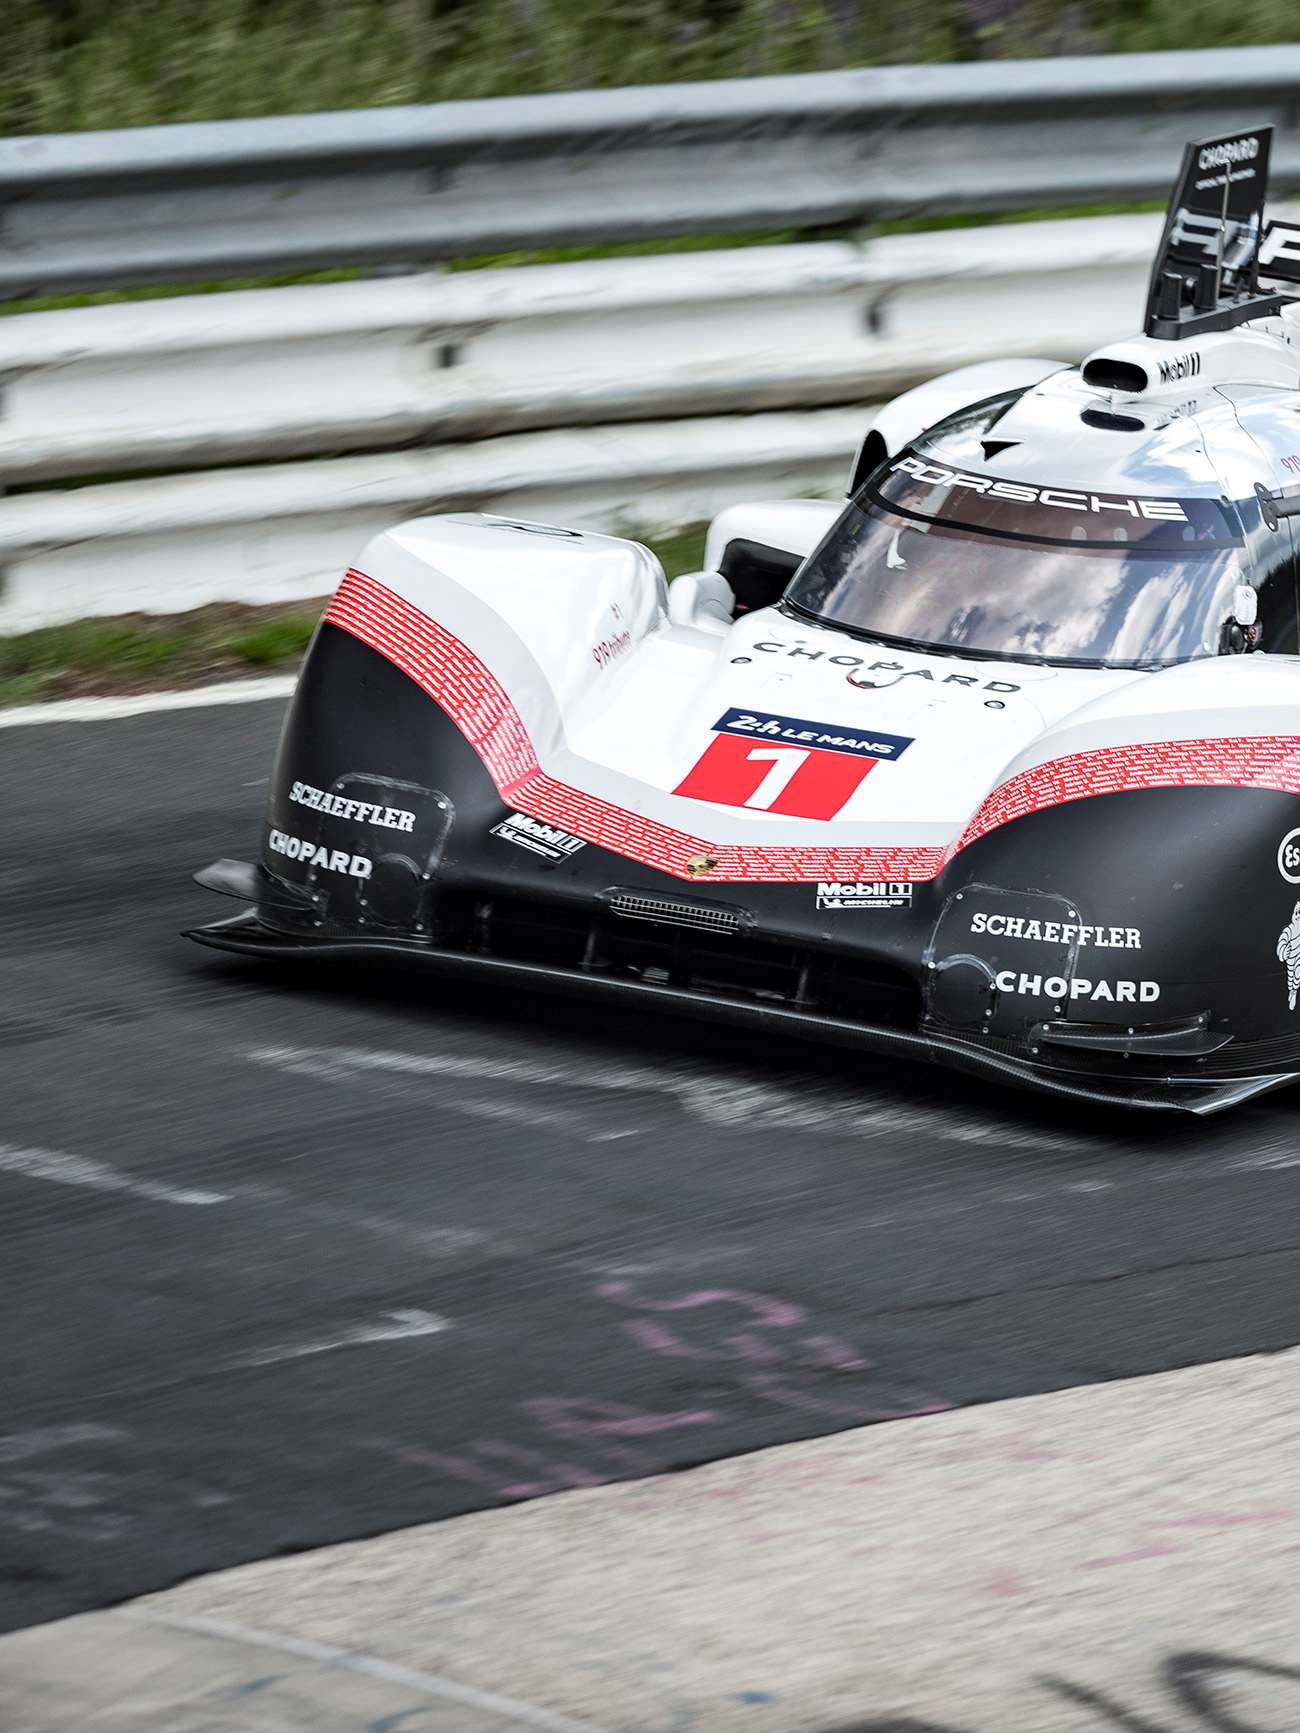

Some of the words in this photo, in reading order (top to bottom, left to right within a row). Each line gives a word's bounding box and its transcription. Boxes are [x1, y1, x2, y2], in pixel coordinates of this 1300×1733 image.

[1157, 354, 1190, 384] Mobil
[890, 457, 1189, 522] PORSCHE
[753, 642, 1022, 693] CHOPARD
[781, 728, 819, 742] LE
[816, 734, 896, 755] MANS
[743, 747, 812, 811] 1
[288, 781, 416, 832] SCHAEFFLER
[504, 812, 568, 844] Mobil
[269, 829, 373, 879] CHOPARD
[817, 882, 886, 896] Mobil
[970, 912, 1142, 949] SCHAEFFLER
[995, 970, 1160, 1002] CHOPARD
